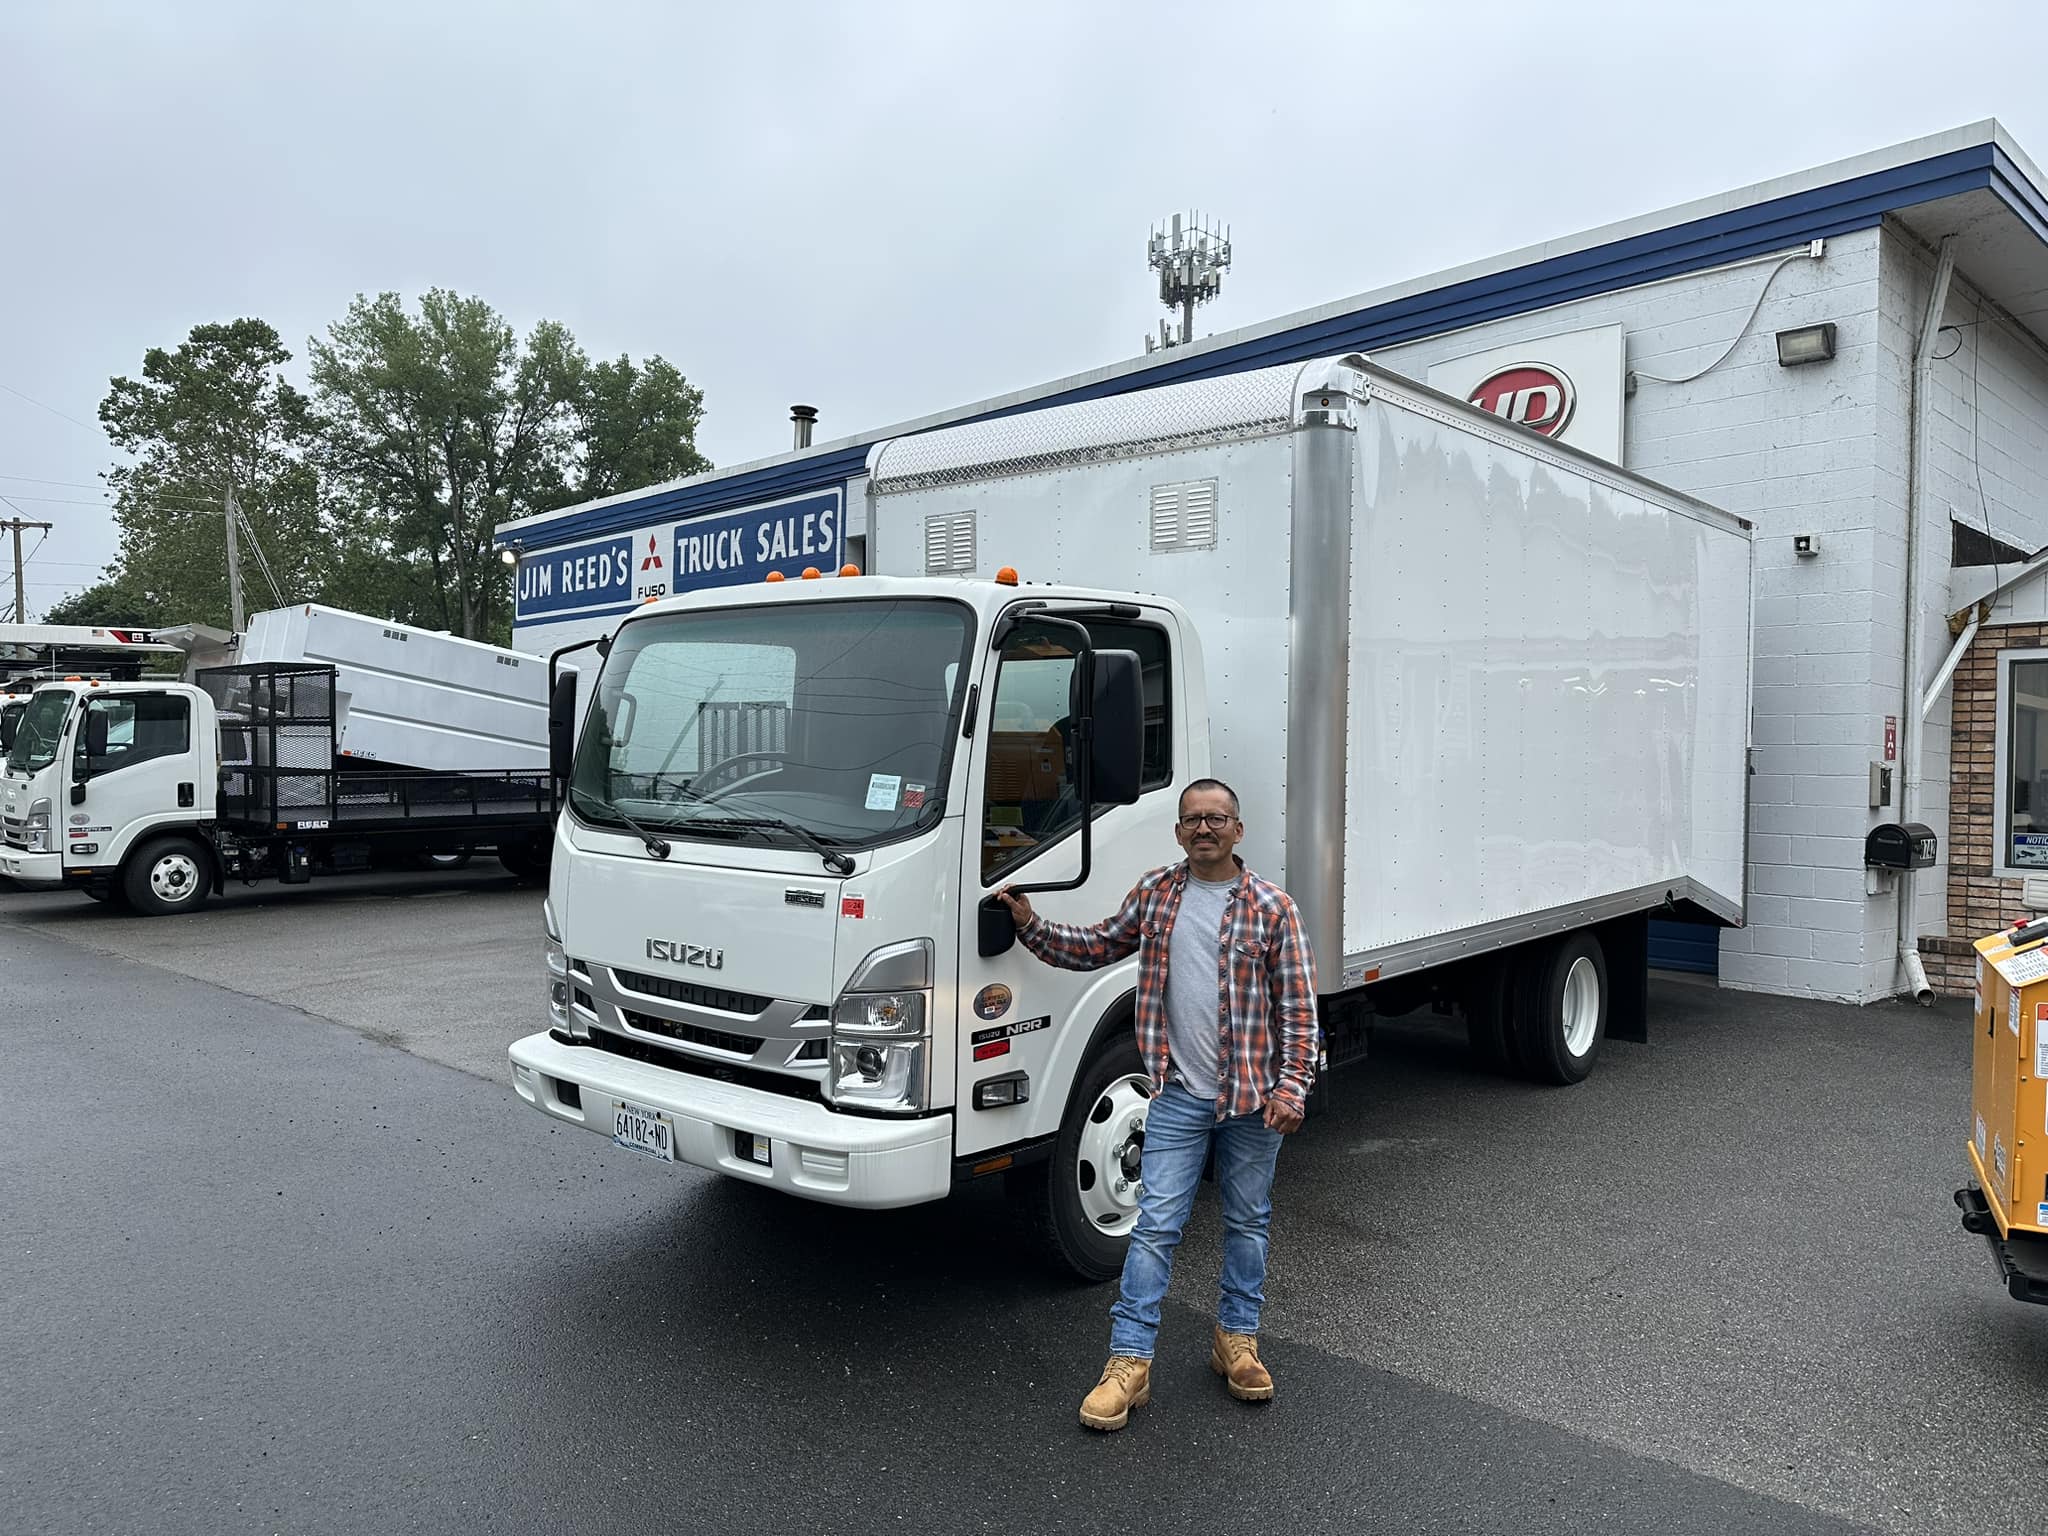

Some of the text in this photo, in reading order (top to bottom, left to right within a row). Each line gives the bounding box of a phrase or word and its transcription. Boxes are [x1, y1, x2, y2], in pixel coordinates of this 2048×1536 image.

[677, 510, 834, 575] TRUCK SALES
[520, 546, 628, 600] JIM REED'S
[637, 583, 666, 599] FUSO
[2026, 836, 2048, 846] NOTIC
[646, 936, 724, 970] ISUZU
[978, 1019, 1043, 1041] ISUZU NRR
[626, 1105, 657, 1121] NEW YORK
